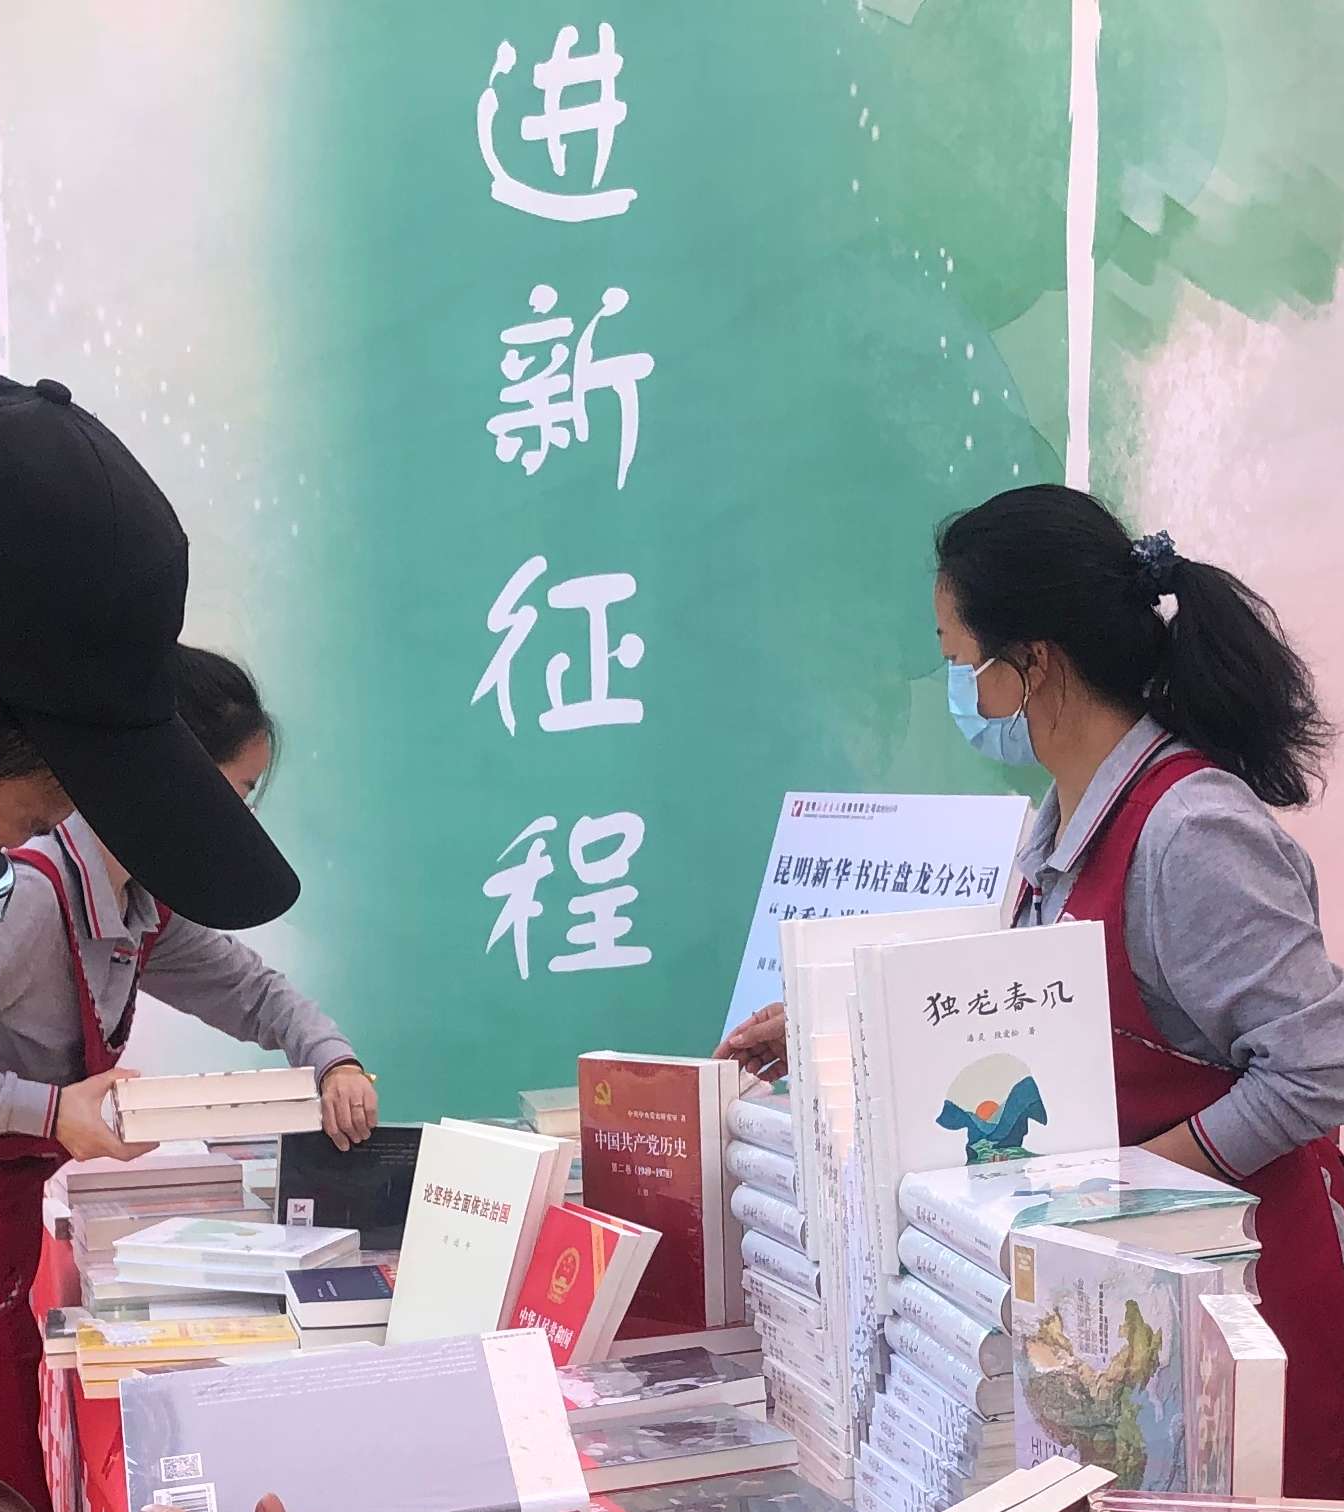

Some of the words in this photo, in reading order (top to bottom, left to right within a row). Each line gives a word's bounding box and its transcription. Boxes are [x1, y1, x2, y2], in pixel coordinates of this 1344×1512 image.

[471, 22, 655, 981] 进新征程
[772, 854, 1001, 899] 昆明新华书店盘龙分公司
[594, 1129, 688, 1159] 中国共产党历史
[423, 1183, 512, 1225] 论坚持全面依法治国
